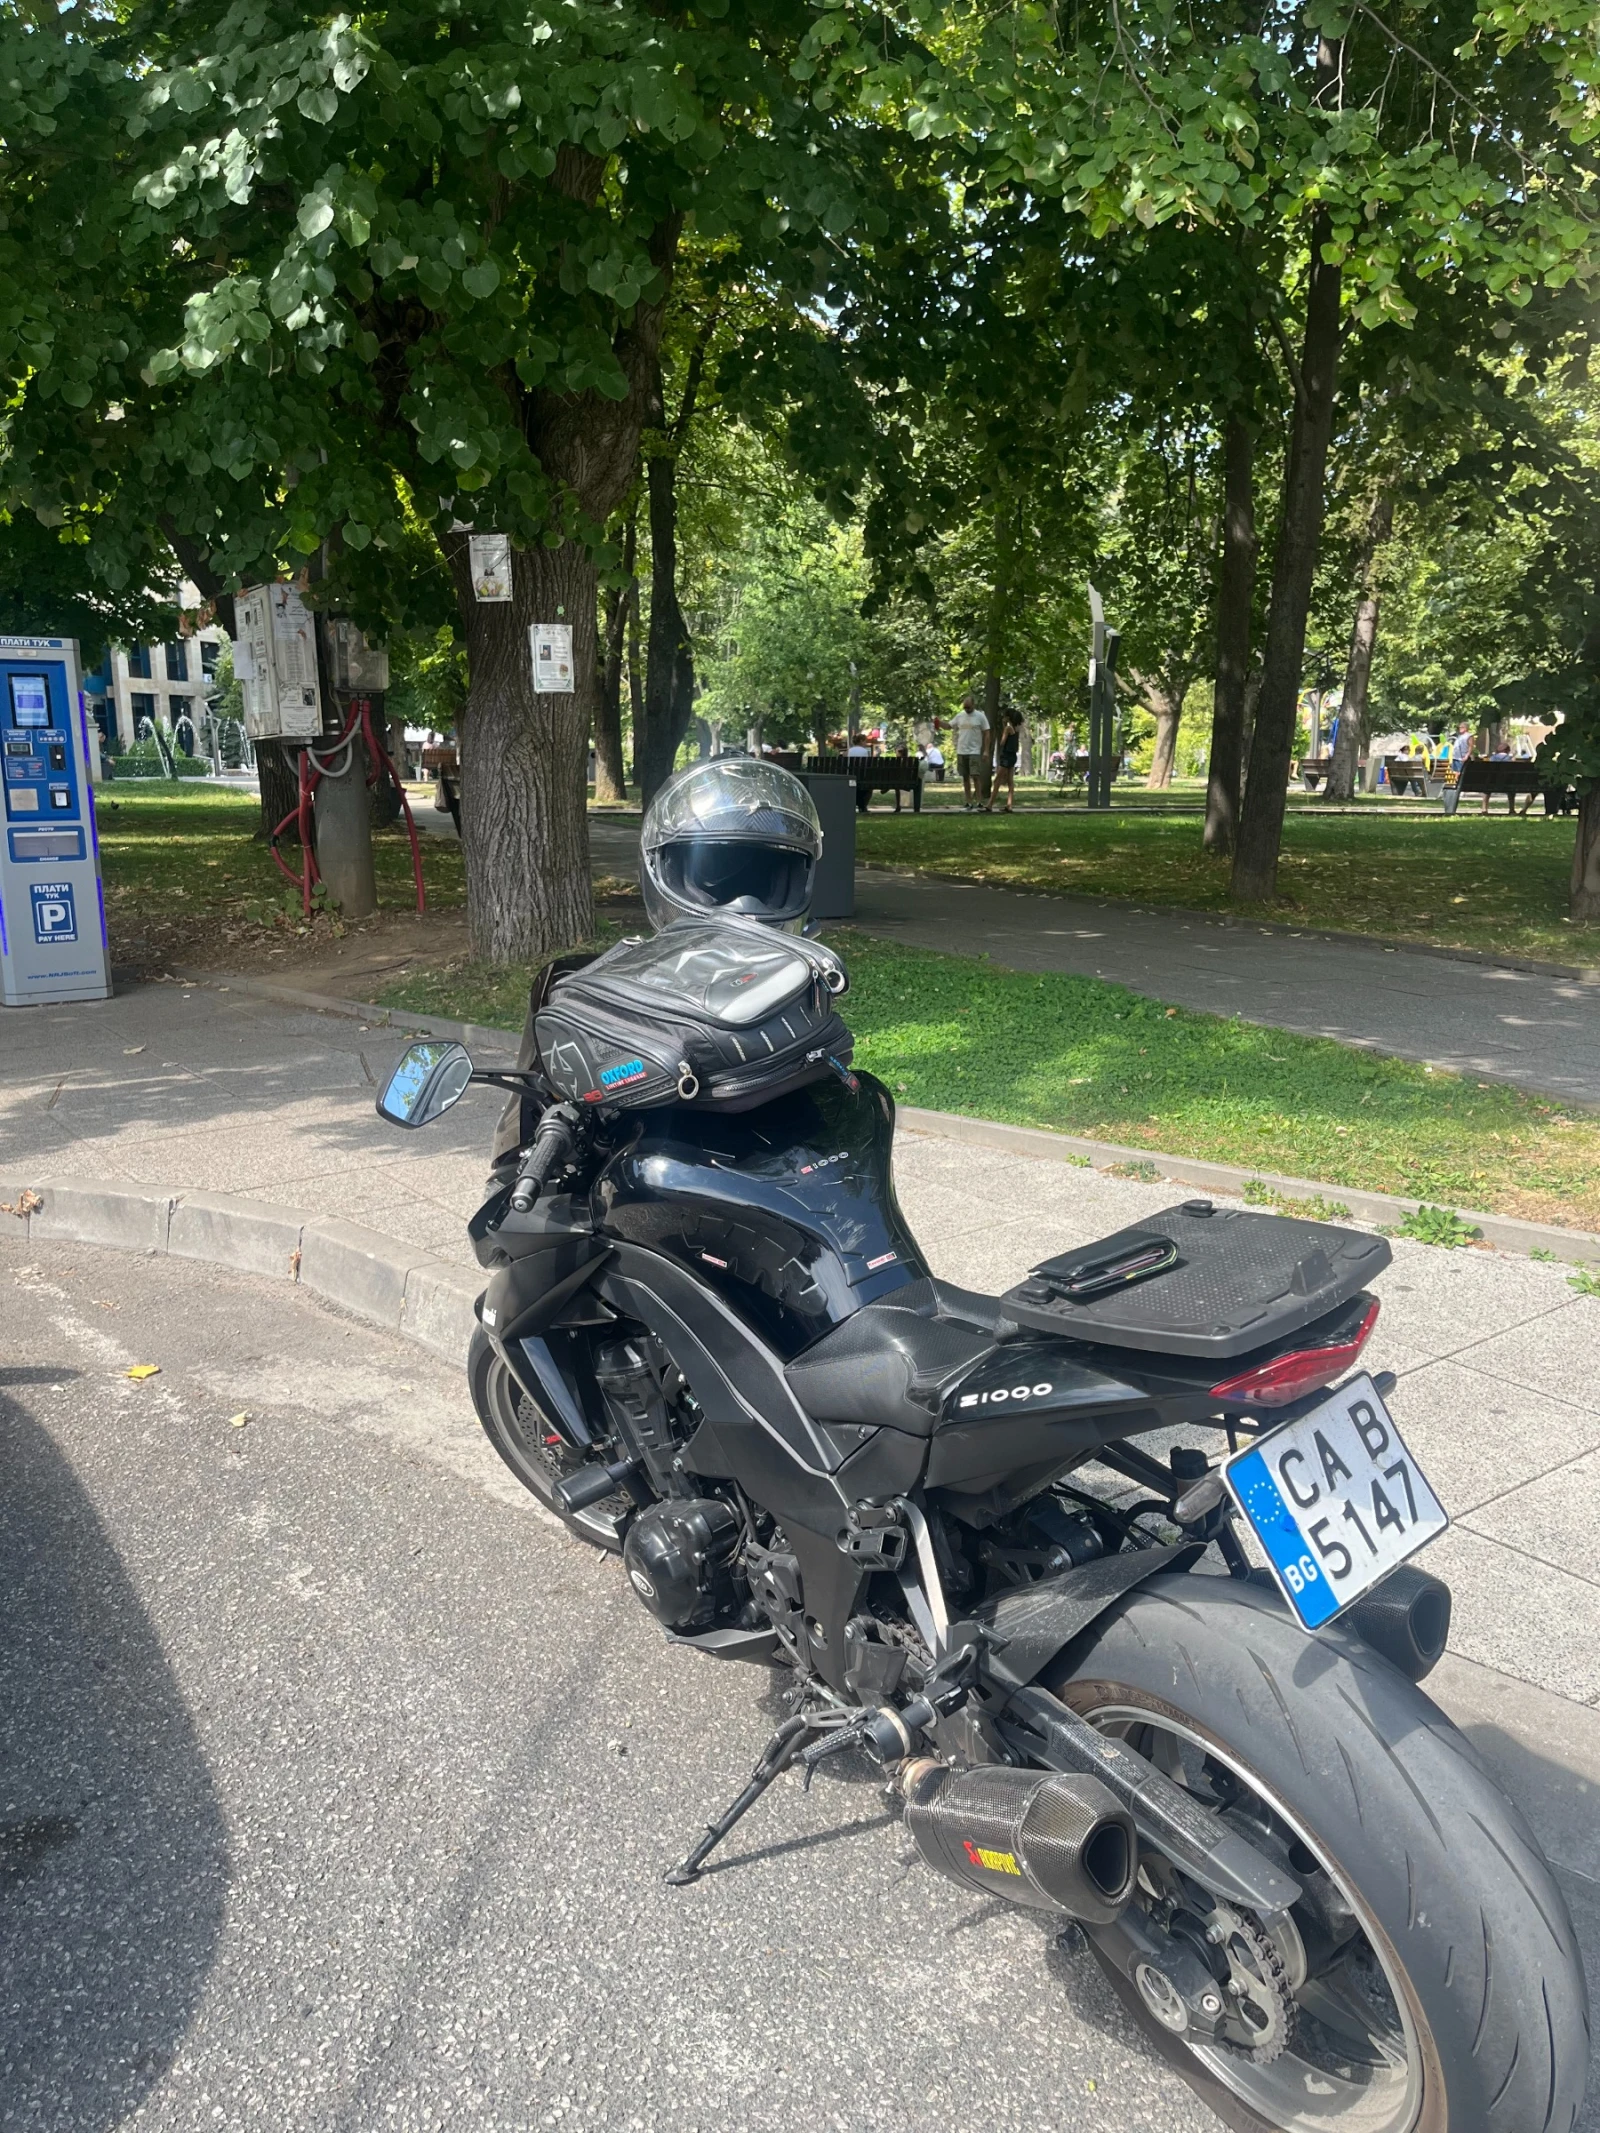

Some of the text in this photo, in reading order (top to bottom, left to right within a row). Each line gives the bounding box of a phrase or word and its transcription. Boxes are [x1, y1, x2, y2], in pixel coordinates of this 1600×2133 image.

[0, 638, 51, 647] ПЛАТИ ТУК
[34, 884, 69, 894] ПЛАТИ
[42, 904, 66, 931] P
[38, 935, 53, 943] PAY
[600, 1059, 644, 1085] OXFORD
[959, 1382, 1053, 1408] Z1000
[1278, 1399, 1390, 1510] CA B
[1307, 1459, 1419, 1580] 5147
[1283, 1555, 1318, 1594] BG
